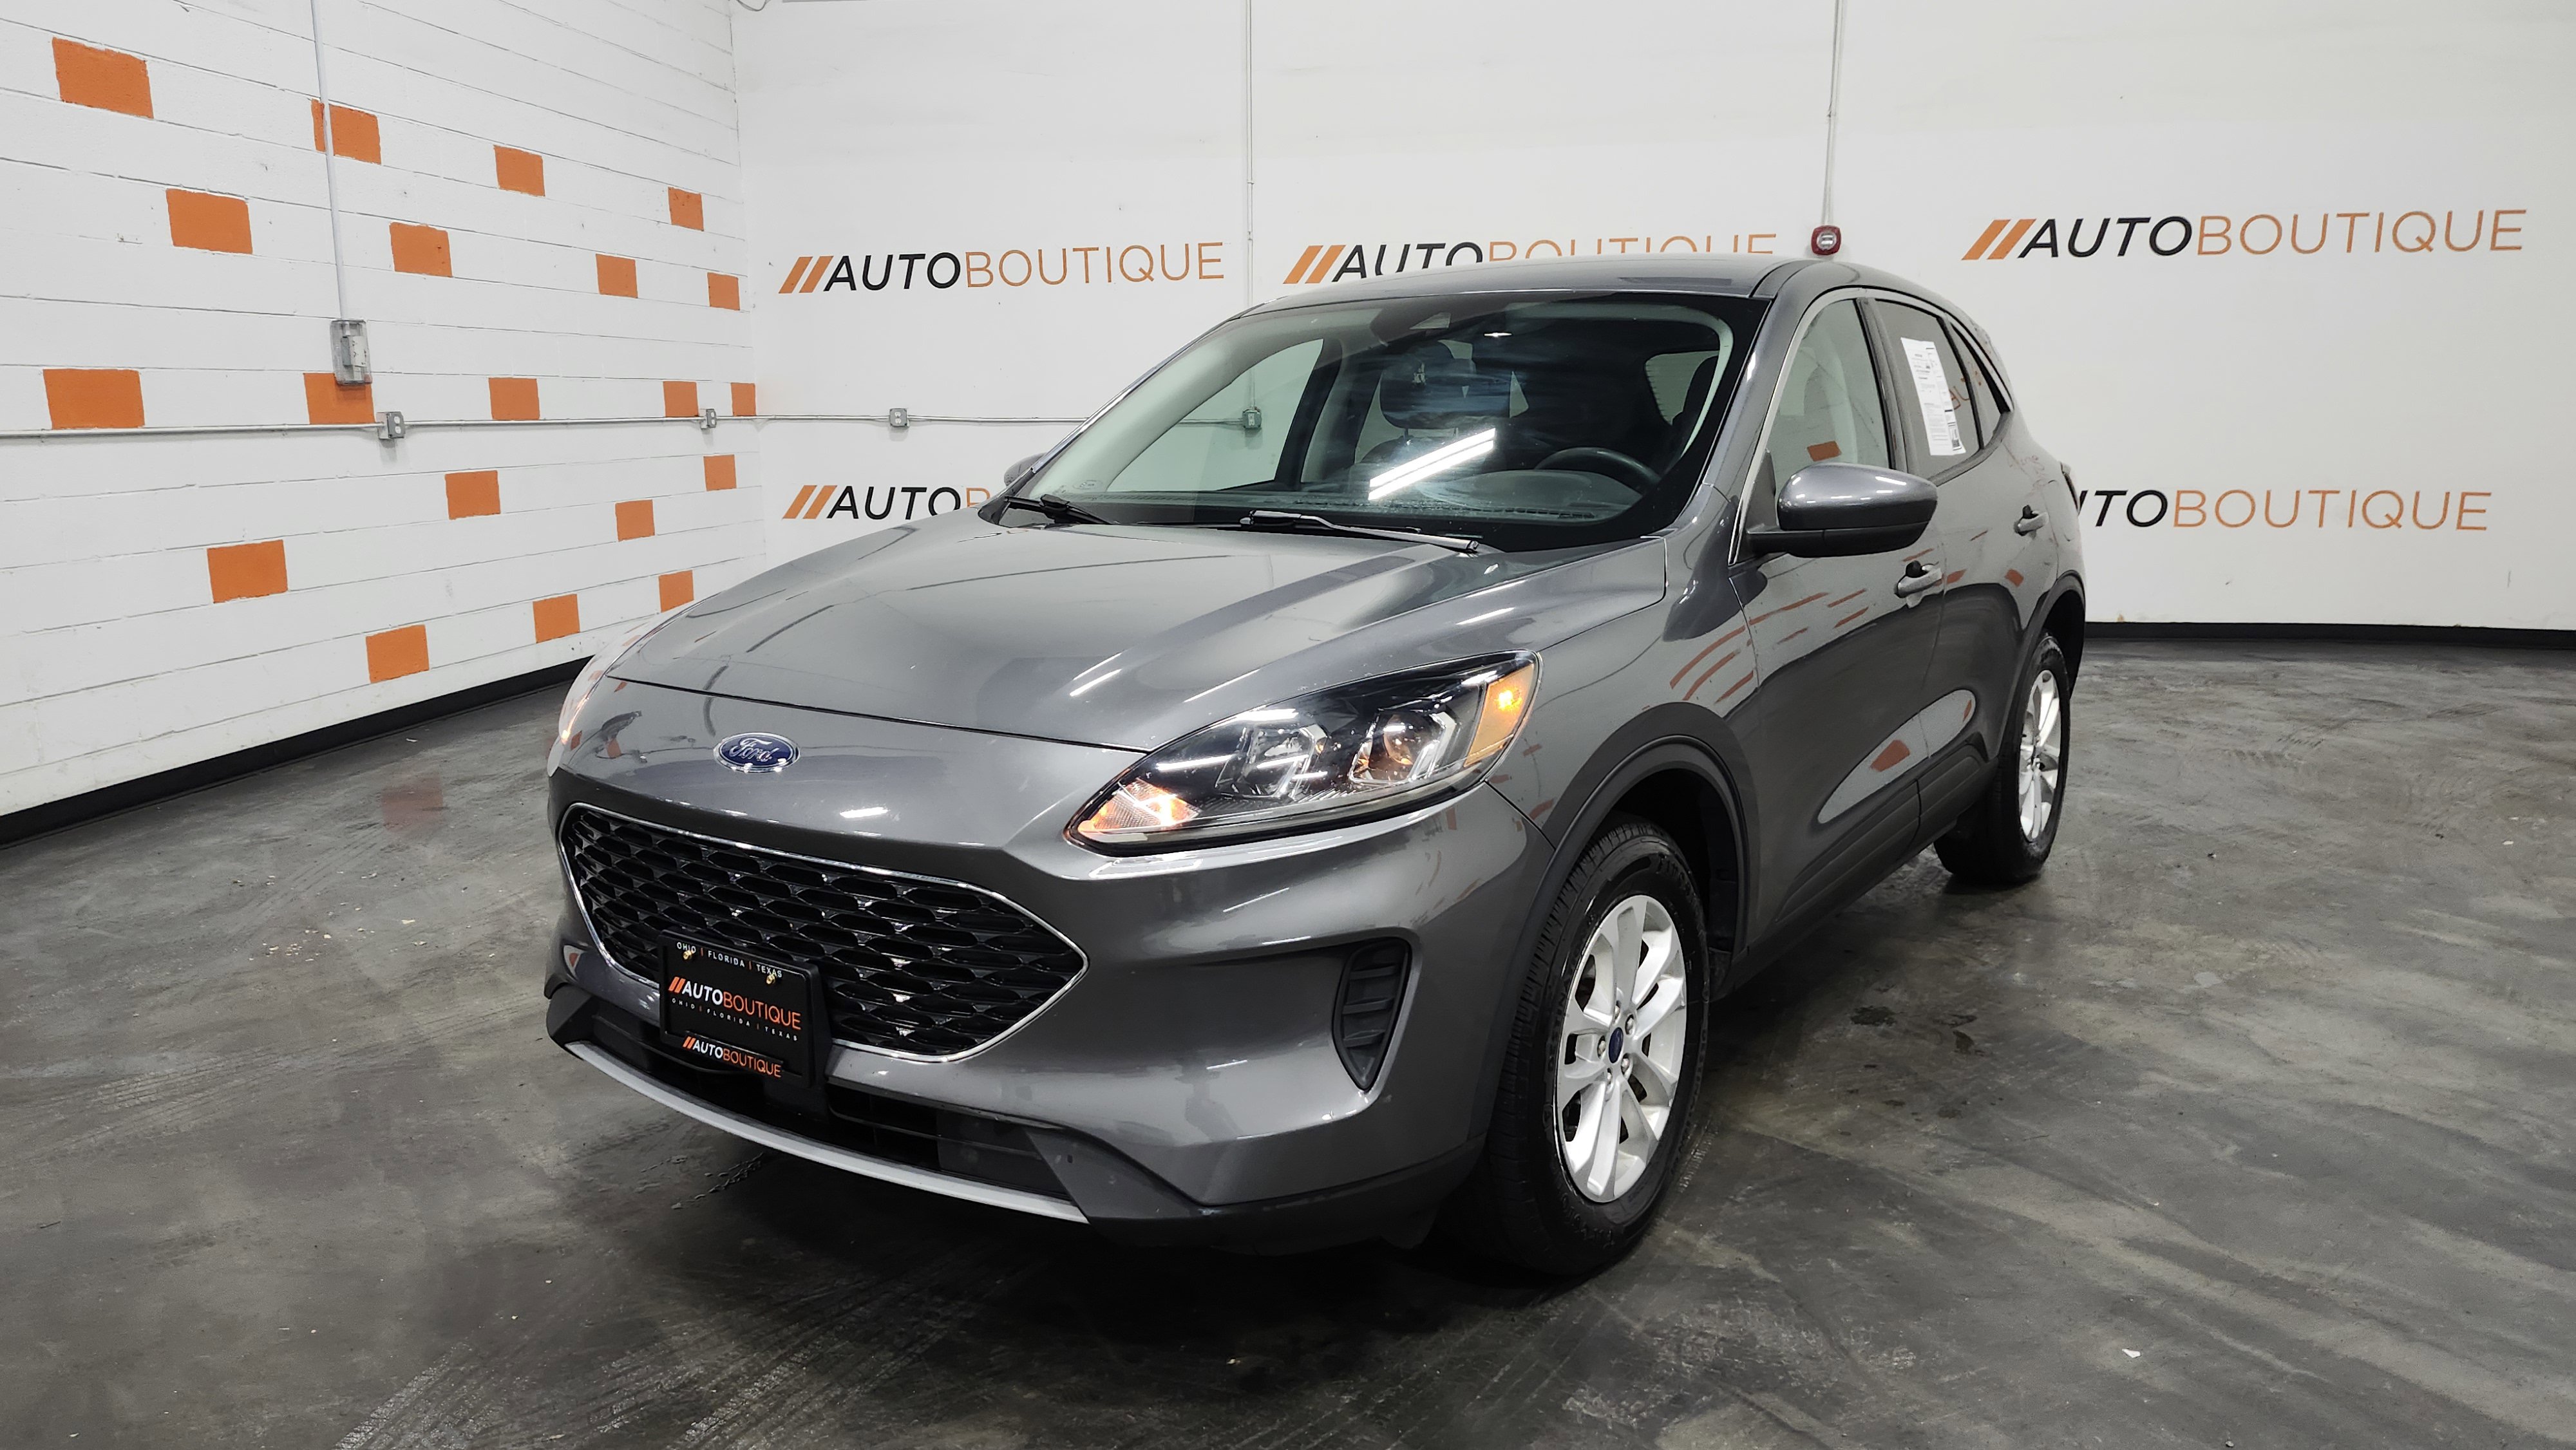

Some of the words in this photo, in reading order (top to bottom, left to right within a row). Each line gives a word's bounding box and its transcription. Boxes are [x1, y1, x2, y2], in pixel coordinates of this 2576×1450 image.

[2018, 209, 2526, 259] AUTOBOUTIQUE
[823, 242, 1224, 292] AUTOBOUTIQUE
[2078, 489, 2492, 531] TOBOUTIQUE
[729, 738, 779, 762] Ford
[677, 942, 696, 953] OHIO
[708, 950, 744, 967] FLORIDA
[756, 965, 782, 977] TEXAS
[672, 998, 695, 1009] OHIO
[707, 1008, 750, 1026] FLORIDA
[765, 1026, 797, 1041] TEXAS
[682, 981, 801, 1030] AUTOBOUTIQUE
[692, 1039, 782, 1078] AUTOBOUTIQUE
